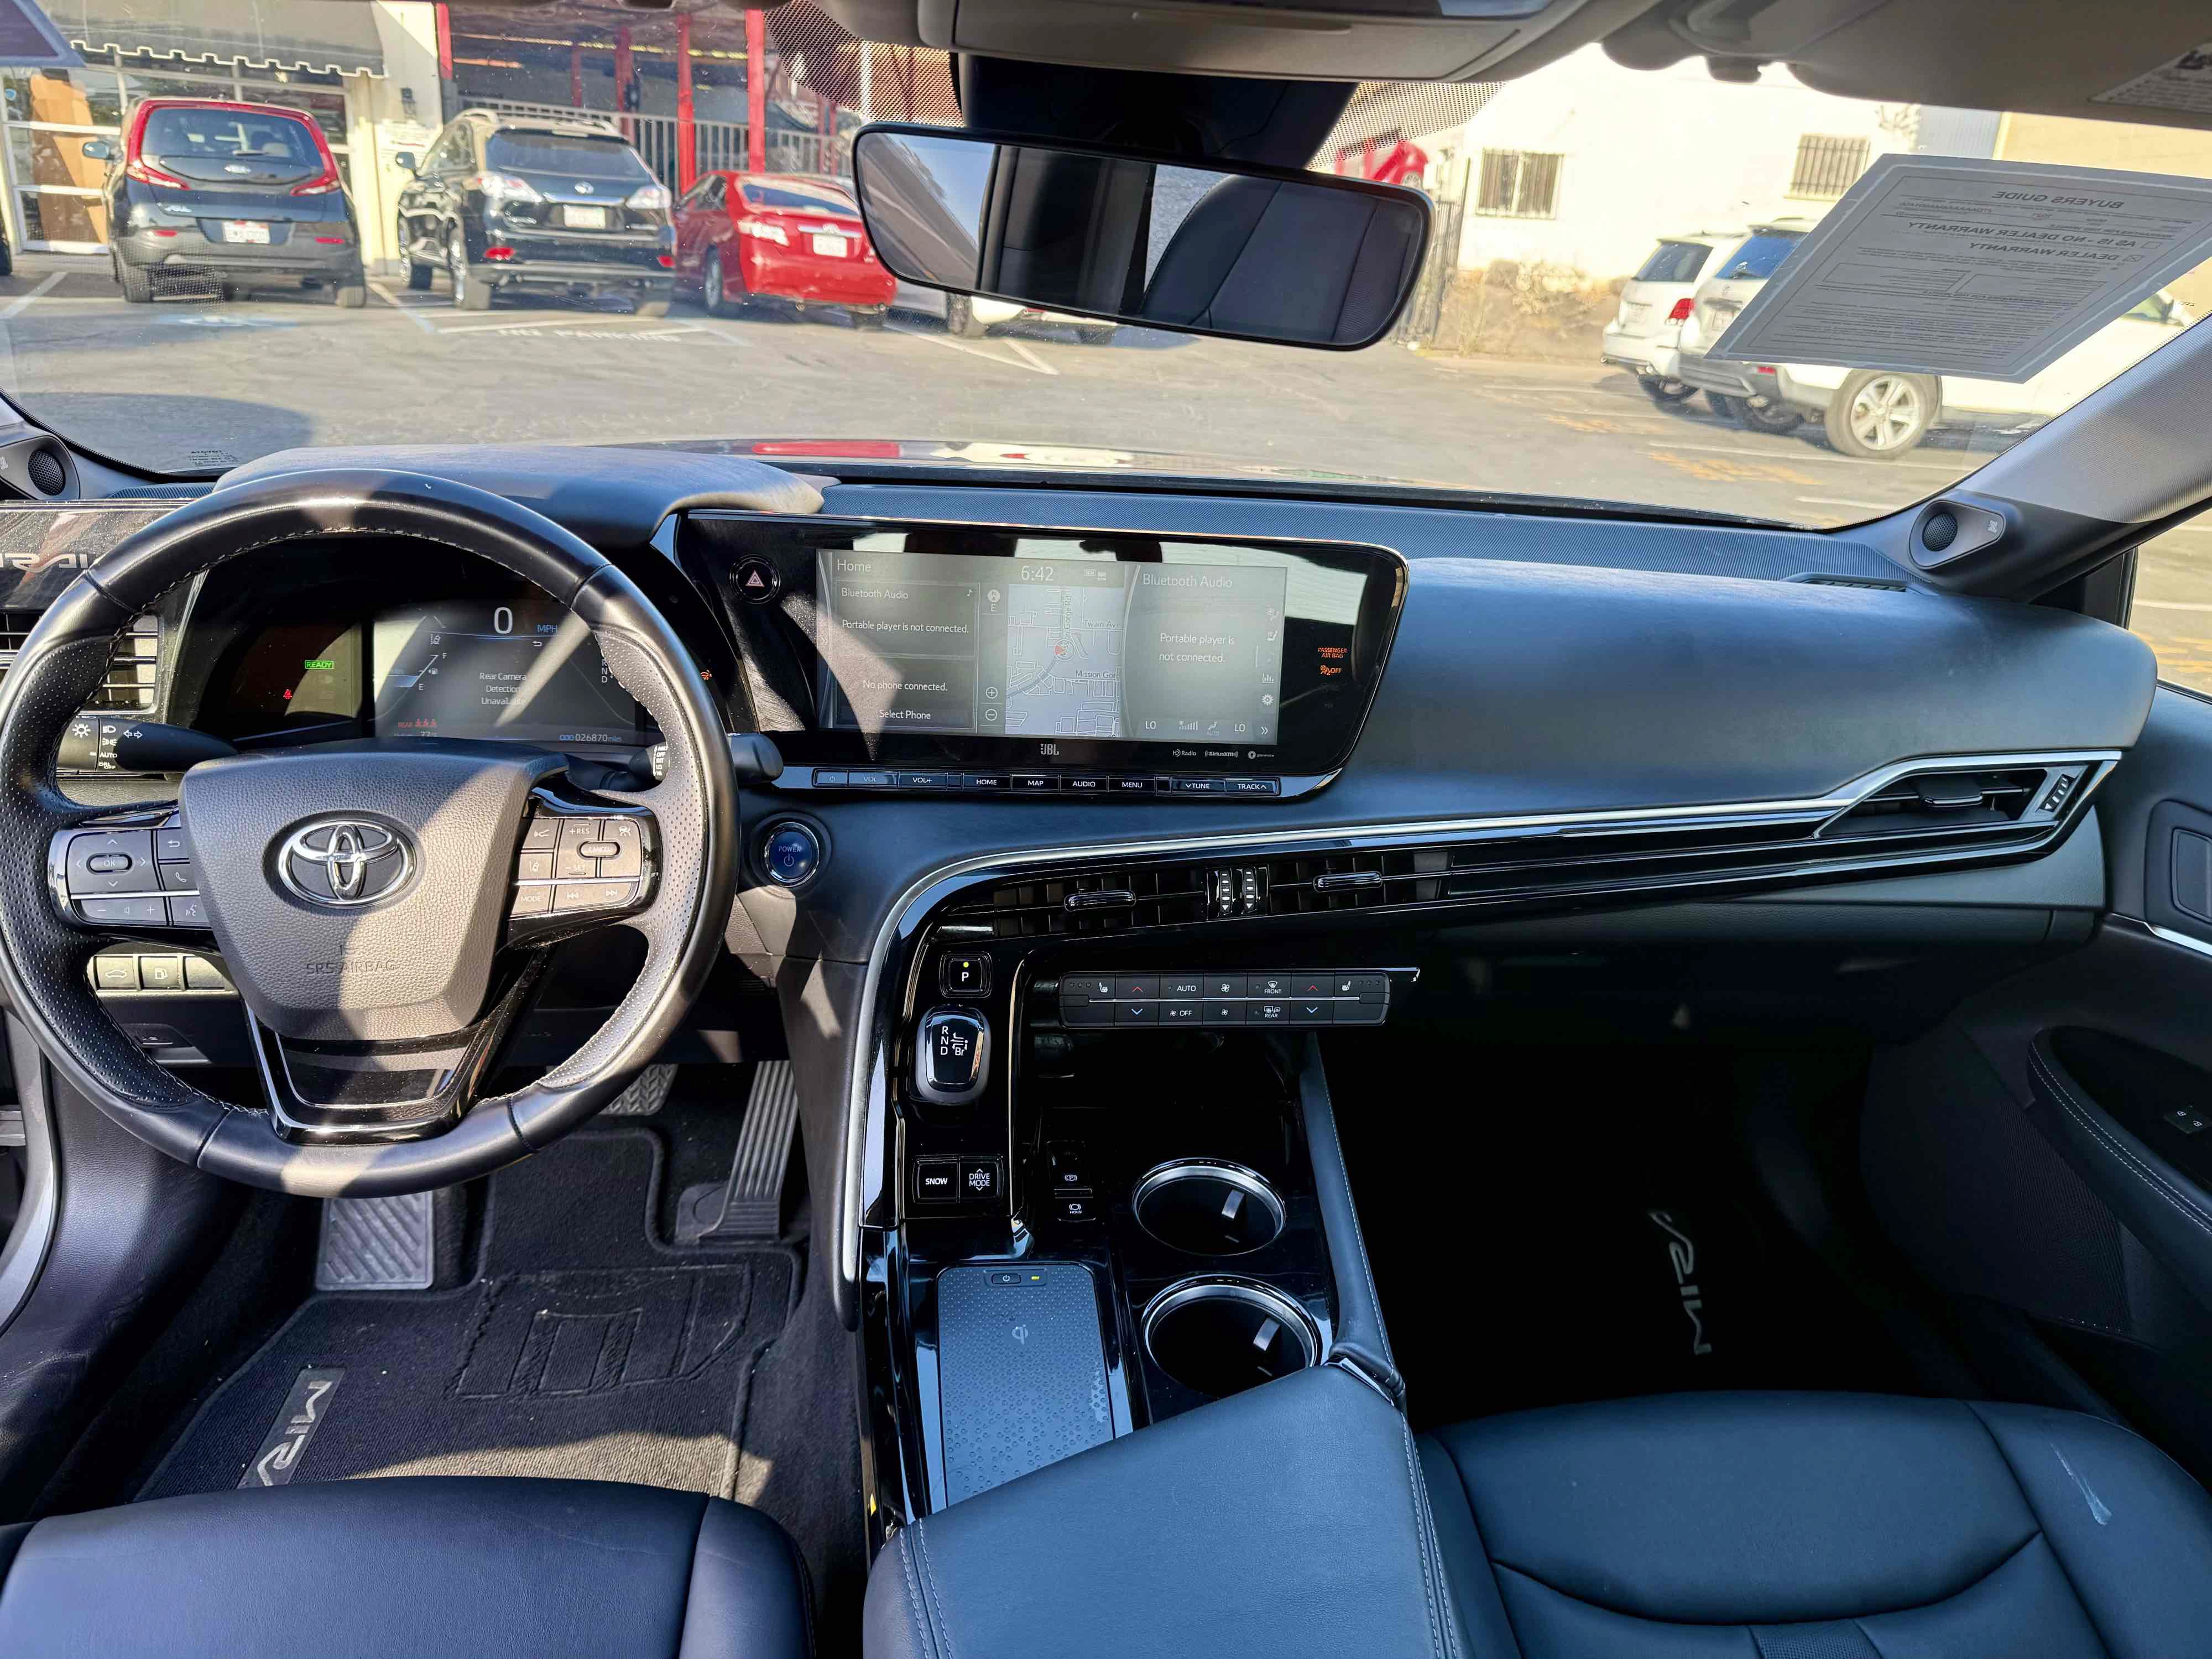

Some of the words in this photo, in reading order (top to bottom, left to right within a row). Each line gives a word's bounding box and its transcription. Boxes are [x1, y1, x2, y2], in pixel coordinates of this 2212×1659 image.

[837, 560, 872, 572] Home
[1021, 566, 1054, 581] 6:42
[1142, 573, 1197, 587] Bluetooth
[1199, 576, 1233, 588] Audio
[841, 588, 882, 599] Bluetooth
[884, 589, 909, 600] Audio
[493, 607, 513, 634] 0
[842, 619, 875, 630] Portable
[876, 621, 901, 632] player
[902, 622, 908, 630] is
[909, 623, 921, 631] not
[922, 623, 969, 633] connected.
[537, 625, 558, 633] MPH
[1160, 633, 1197, 645] Portable
[1198, 635, 1227, 646] player
[1228, 636, 1235, 645] is
[1159, 653, 1173, 662] not
[1175, 653, 1225, 664] connected.
[498, 673, 527, 681] Camera
[863, 680, 875, 690] No
[877, 681, 902, 693] phone
[904, 681, 947, 692] connected.
[879, 710, 904, 719] Select
[905, 710, 931, 720] Phone
[1145, 721, 1156, 730] LO
[1234, 723, 1246, 733] LO
[1040, 743, 1060, 755] JBL
[103, 858, 116, 868] OK
[306, 962, 333, 974] SRS
[339, 959, 397, 974] AIRBAG
[961, 972, 969, 982] P
[942, 1026, 949, 1035] R
[941, 1036, 949, 1045] N
[940, 1046, 948, 1056] D
